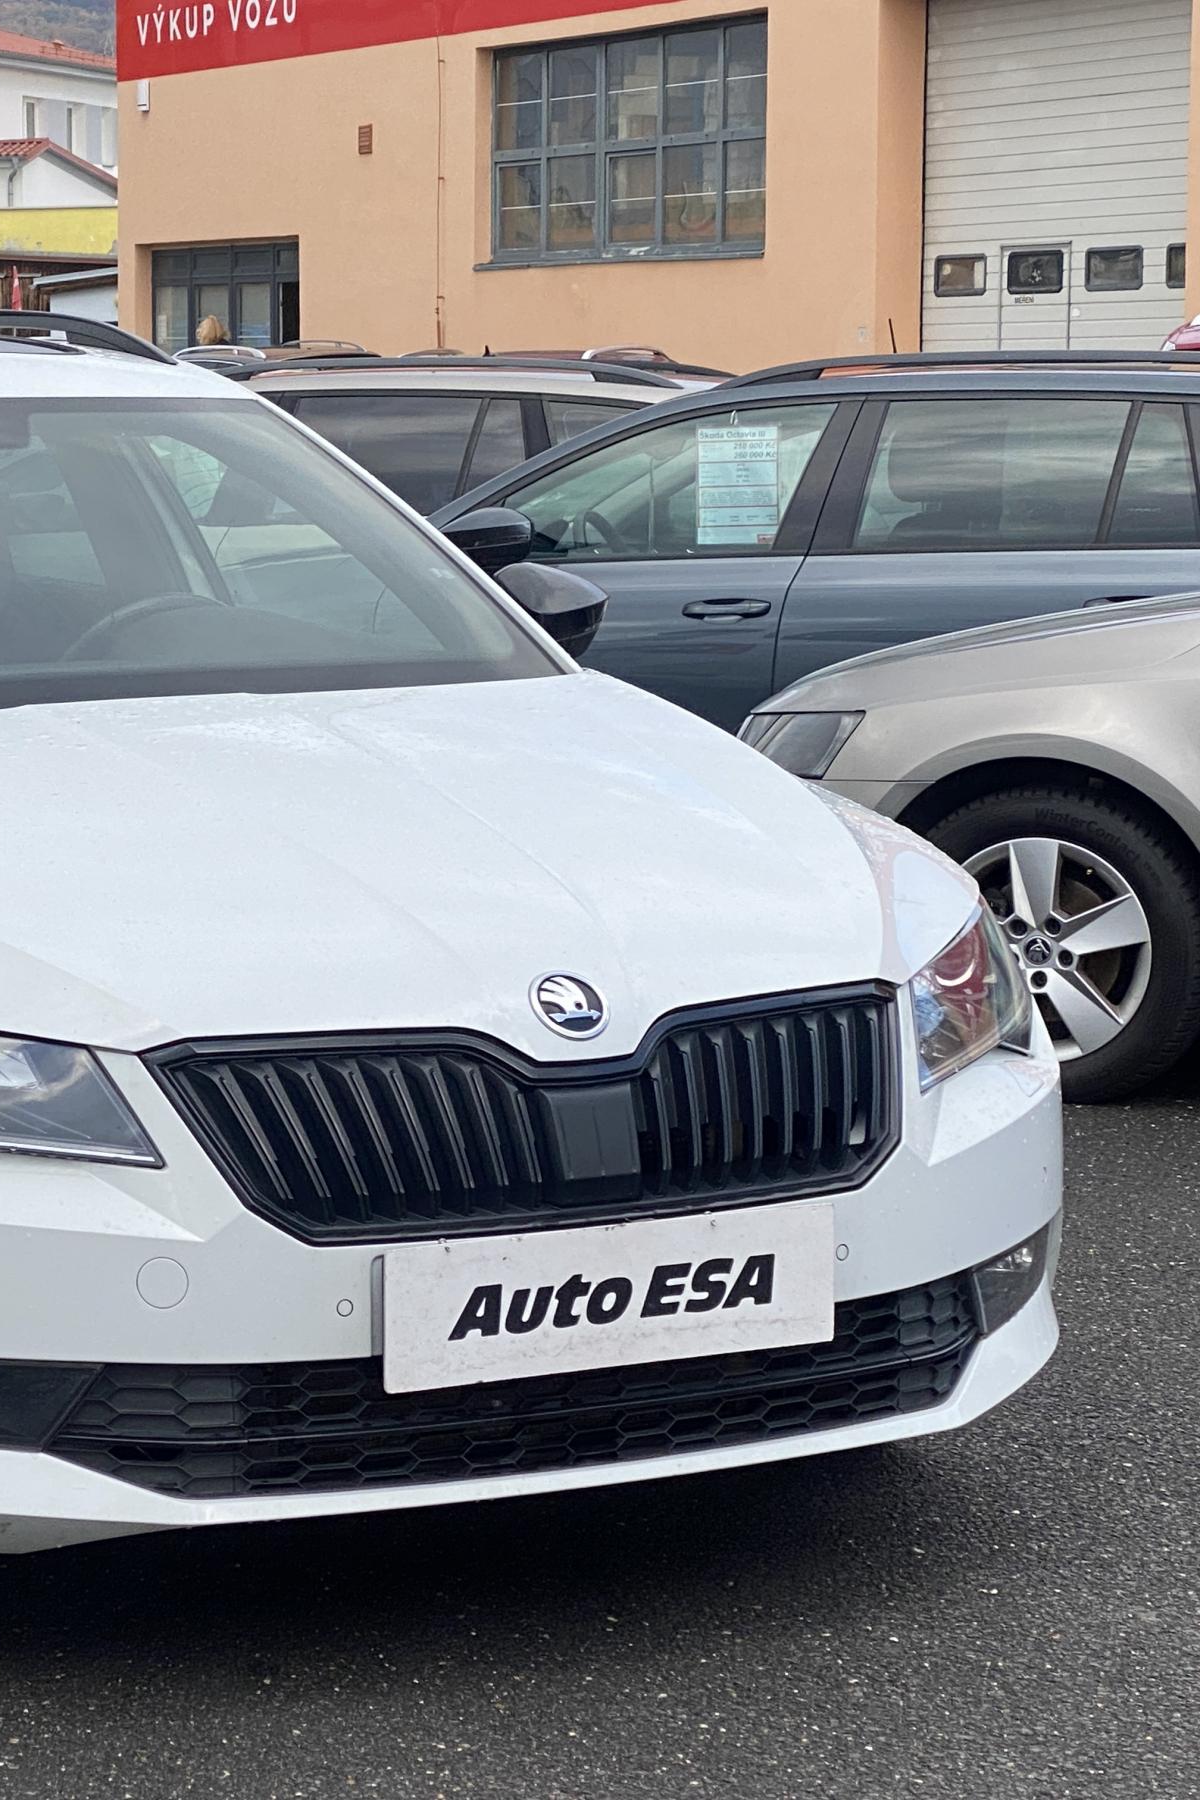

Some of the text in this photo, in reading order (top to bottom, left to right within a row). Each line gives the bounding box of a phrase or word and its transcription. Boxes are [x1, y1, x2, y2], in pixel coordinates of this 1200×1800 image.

[136, 4, 215, 47] VÝKUP
[448, 1253, 776, 1341] Auto ESA
